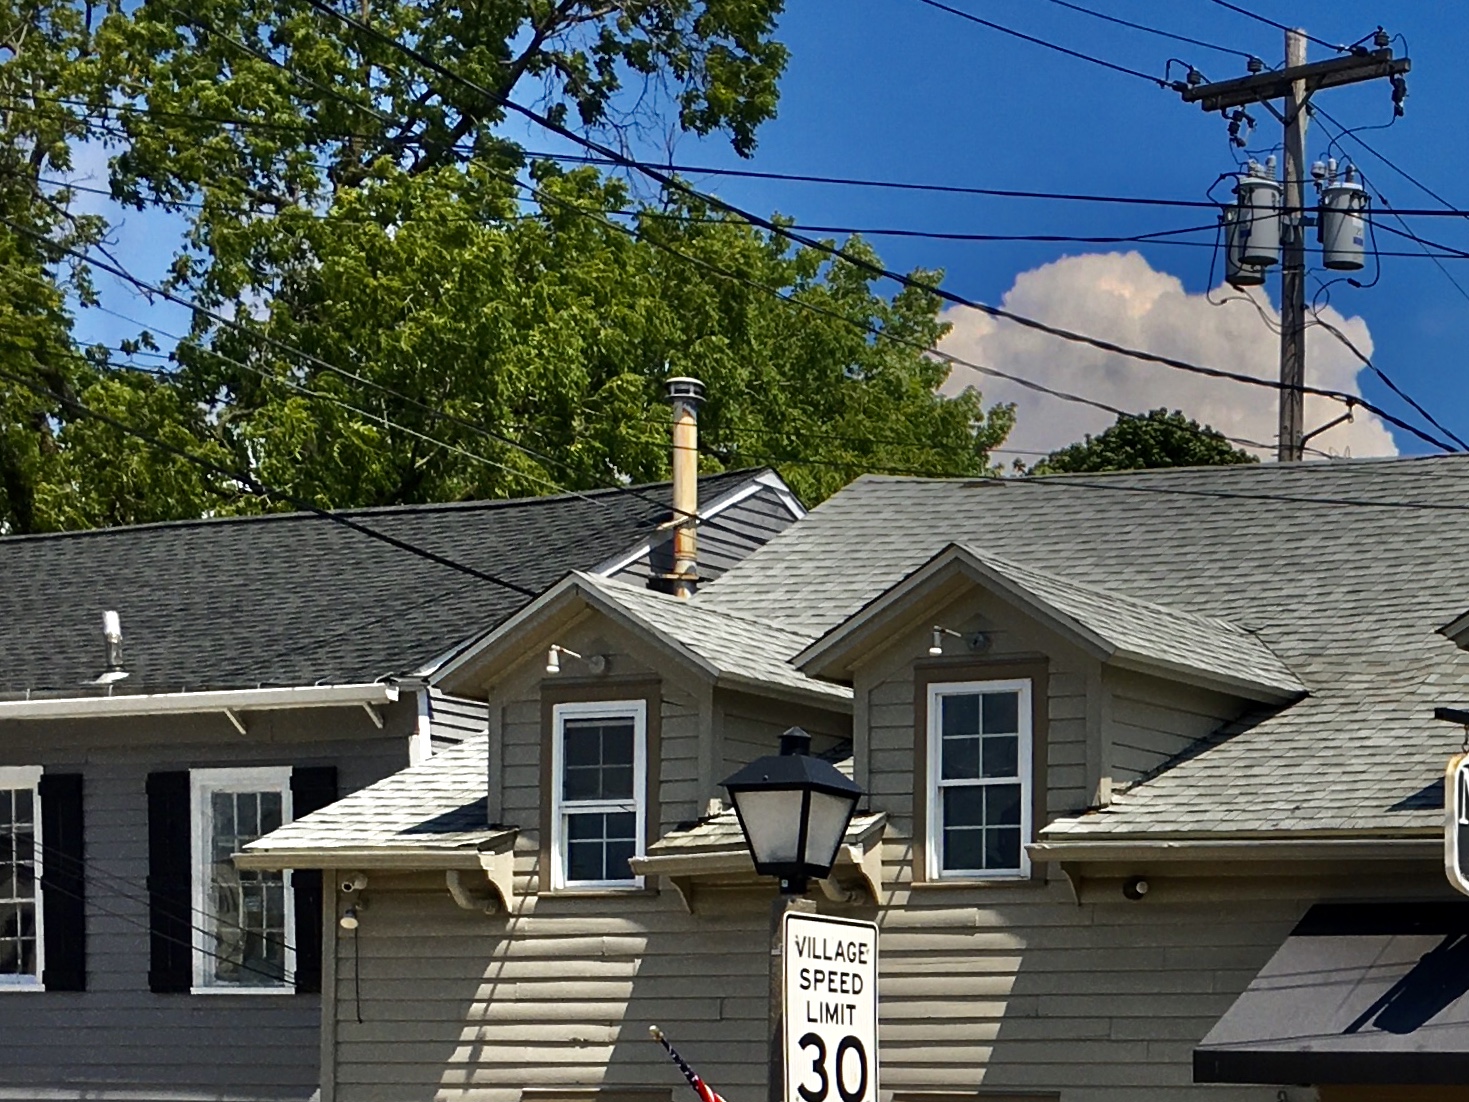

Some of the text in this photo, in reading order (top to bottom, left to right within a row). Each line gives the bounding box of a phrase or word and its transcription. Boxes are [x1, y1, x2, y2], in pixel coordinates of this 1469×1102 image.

[795, 934, 869, 965] VILLAGE
[799, 967, 864, 995] SPEED
[806, 1000, 857, 1026] LIMIT
